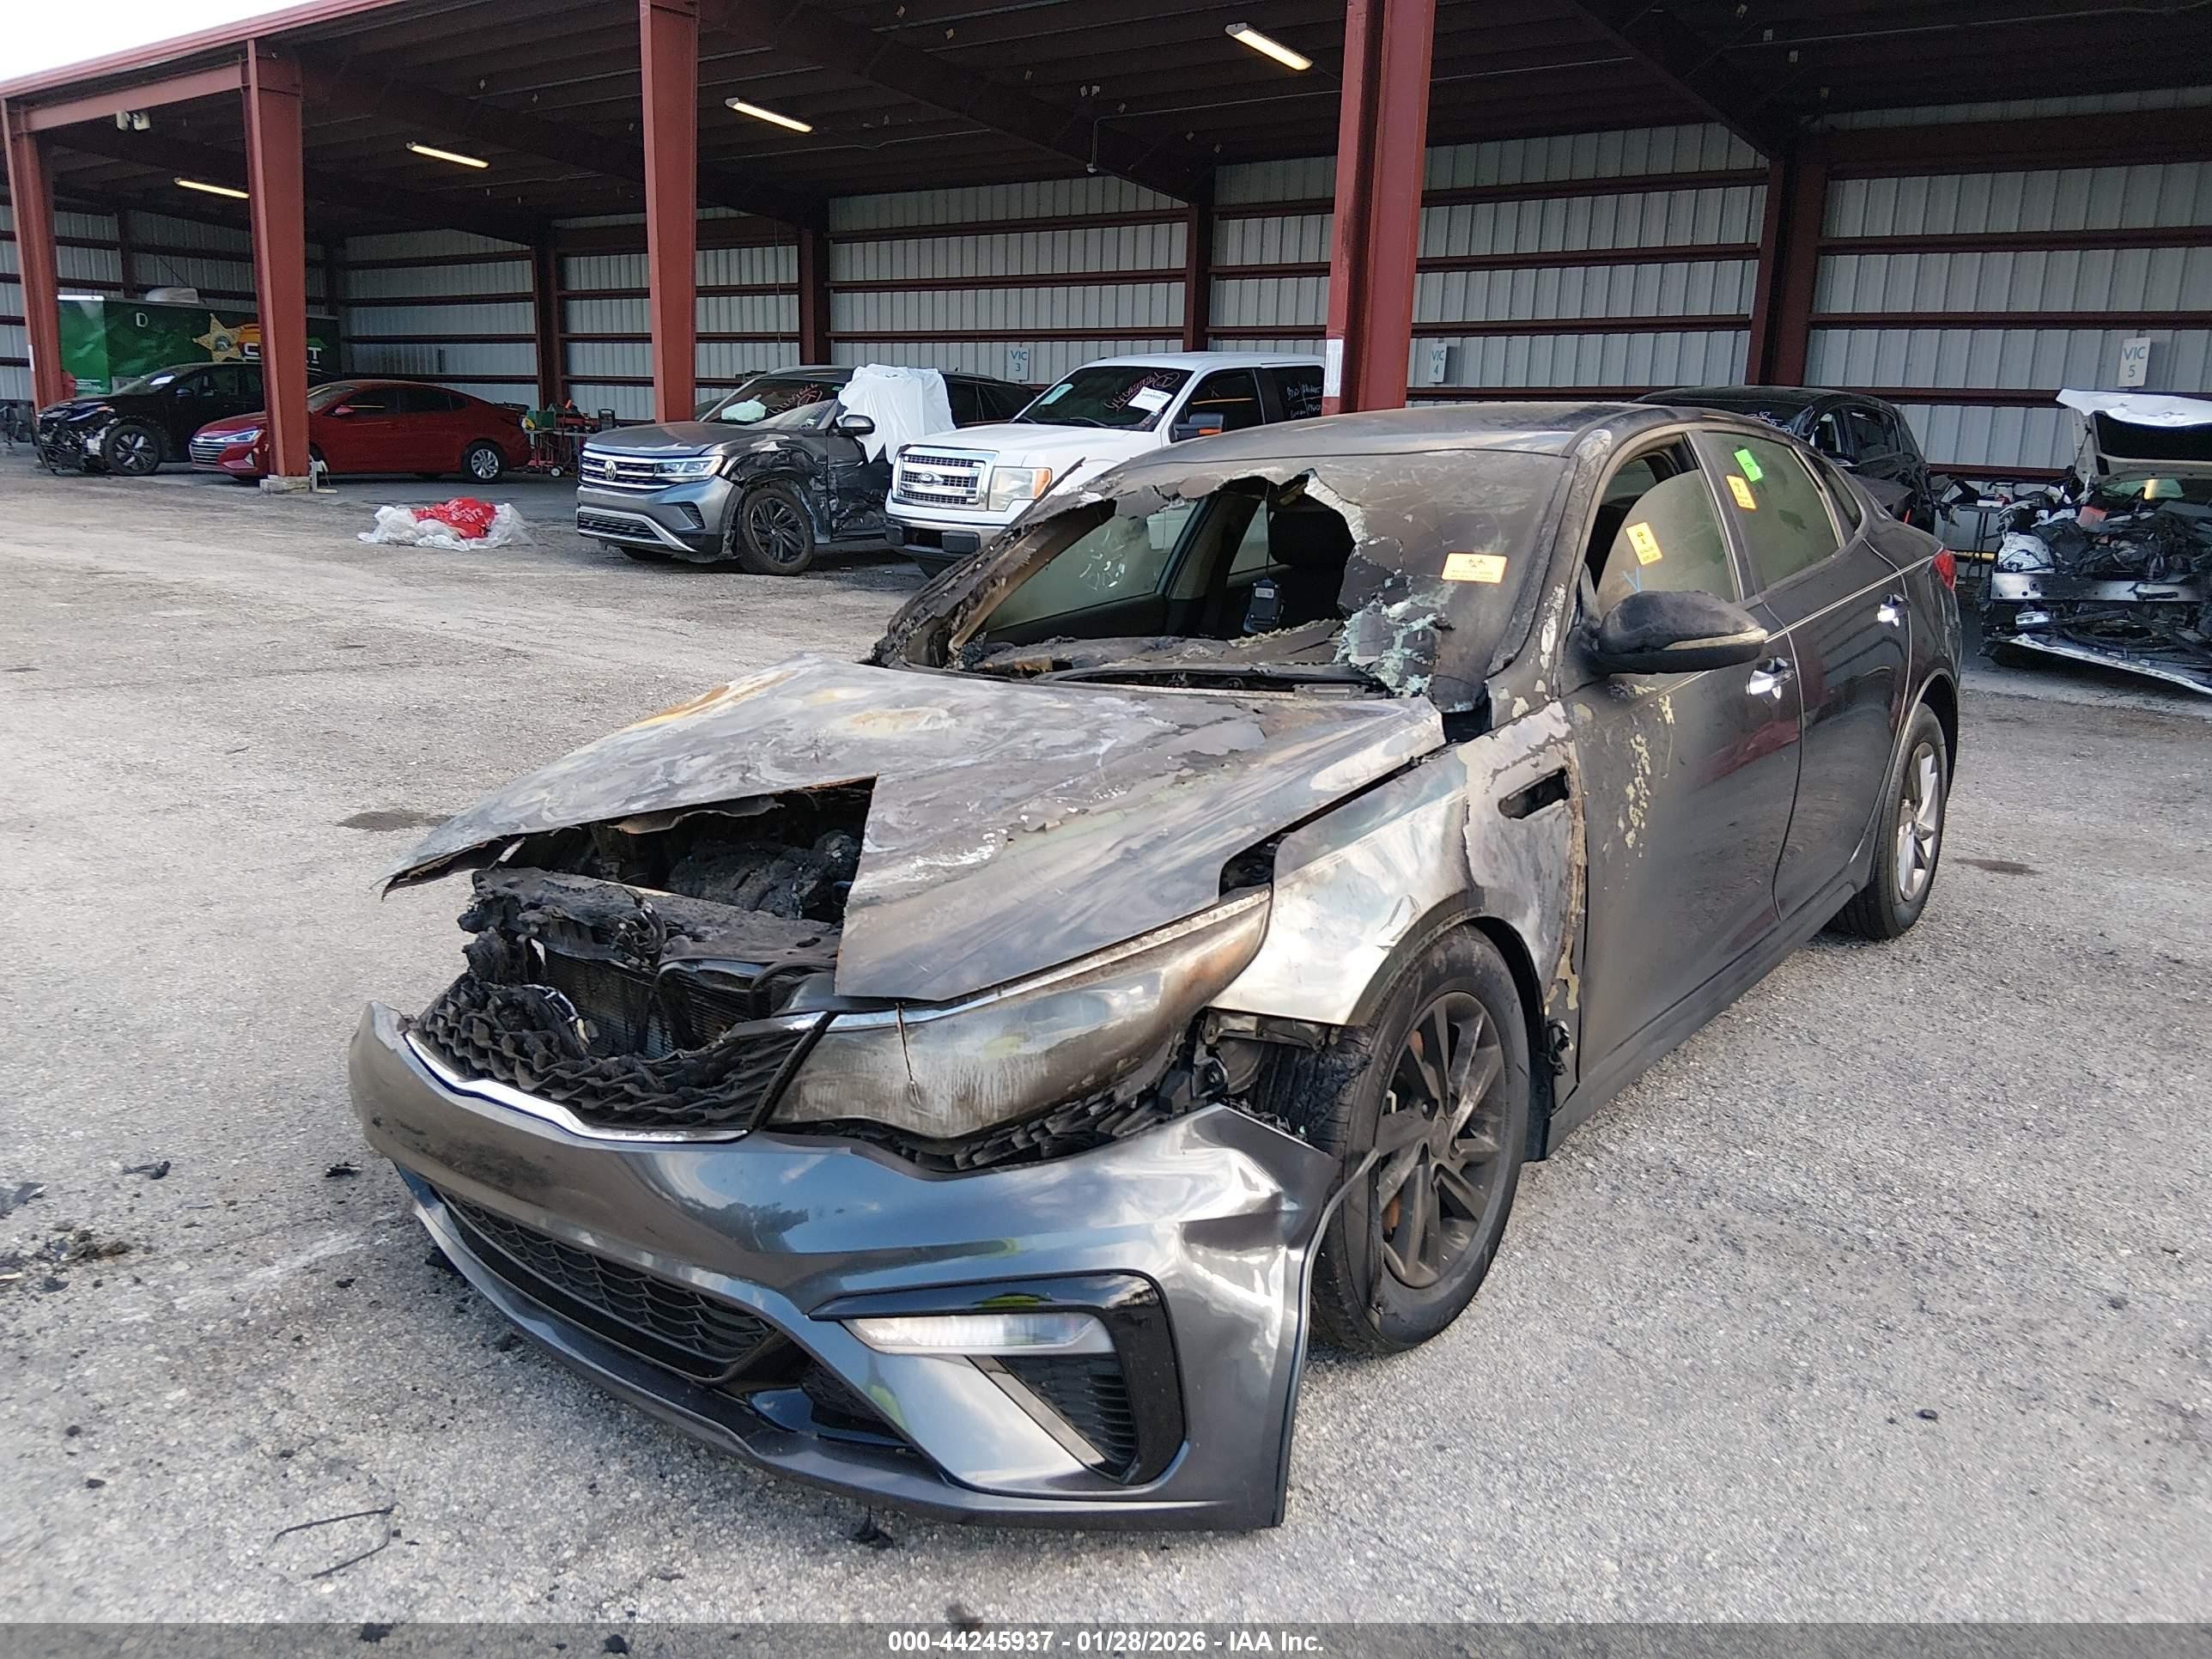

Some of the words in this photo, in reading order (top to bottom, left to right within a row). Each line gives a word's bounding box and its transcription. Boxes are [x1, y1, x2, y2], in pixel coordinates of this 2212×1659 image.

[1010, 349, 1028, 361] VIC
[2123, 346, 2146, 361] VIC
[1015, 362, 1021, 372] 3
[2128, 364, 2136, 379] 5
